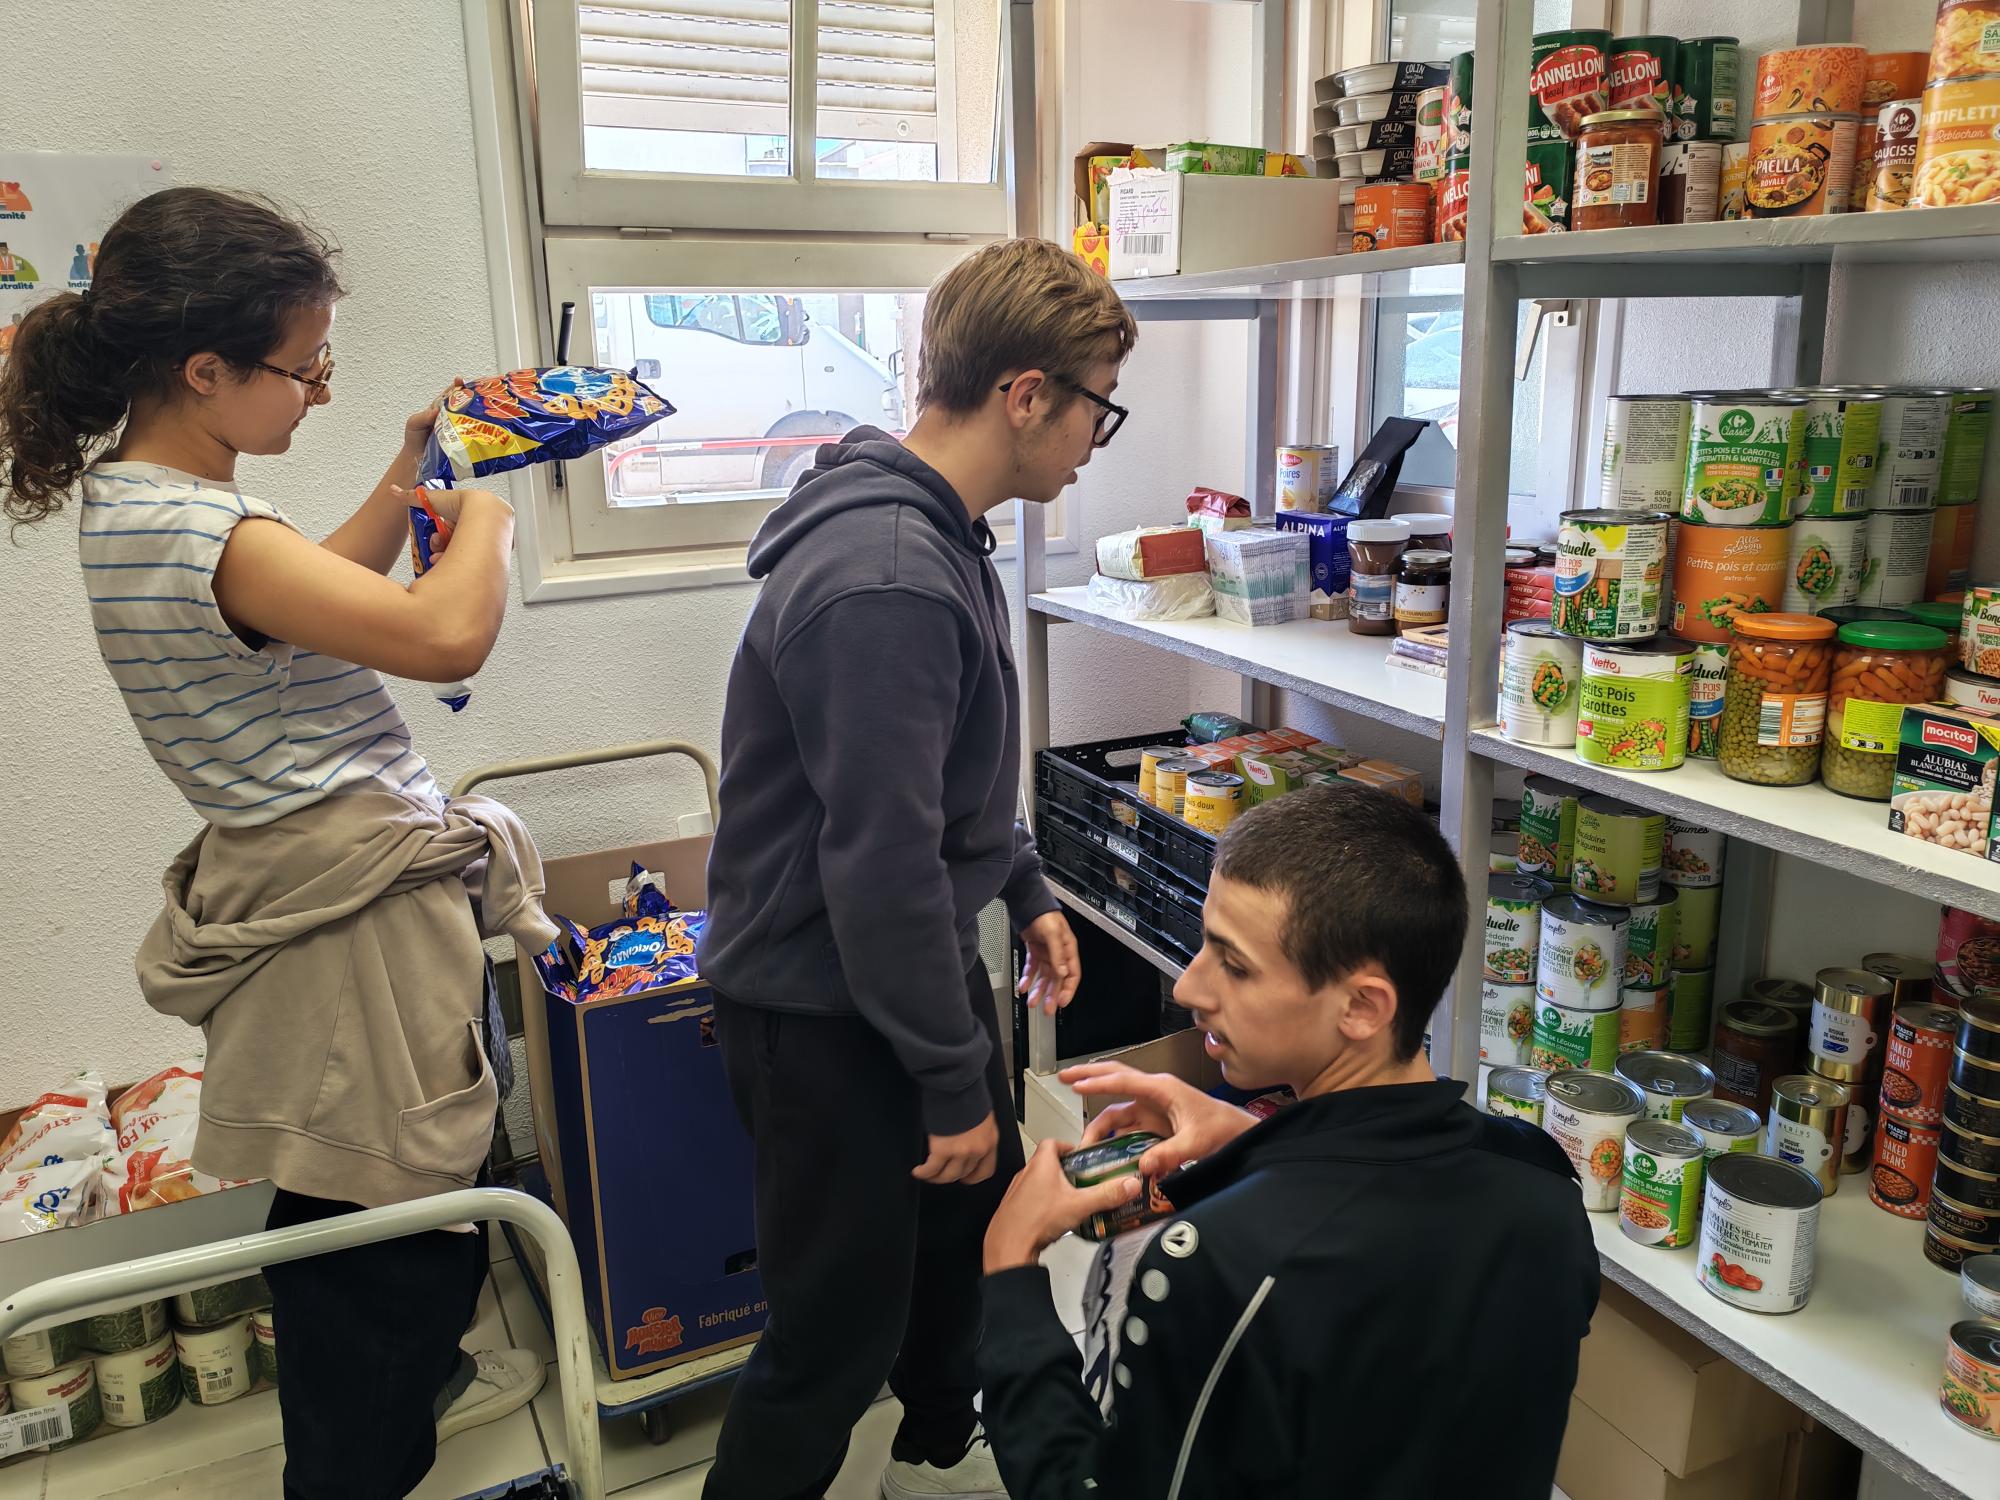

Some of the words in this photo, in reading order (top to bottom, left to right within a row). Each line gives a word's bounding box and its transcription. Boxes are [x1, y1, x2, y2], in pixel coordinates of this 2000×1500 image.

[1984, 29, 2000, 39] SA
[1529, 55, 1604, 92] CANNELLONI
[1380, 121, 1405, 134] COLIN
[1756, 157, 1800, 175] PAËLLA
[1742, 448, 1780, 460] CAROTTES
[1282, 521, 1326, 538] ALPINA
[1686, 556, 1714, 570] Petits
[1716, 560, 1740, 573] pois
[1742, 562, 1754, 572] et
[1591, 657, 1617, 670] Netto
[1582, 678, 1603, 698] Petits
[1608, 686, 1636, 702] Pois
[1703, 683, 1720, 692] POIS
[1582, 695, 1626, 716] Carottes
[1926, 726, 1974, 744] mocitos
[1910, 759, 1944, 774] BLANCAS
[1944, 768, 1979, 782] COCIDAS
[1924, 754, 1968, 772] ALUBIAS
[612, 940, 661, 964] ORIGINAL
[1556, 1036, 1585, 1052] LÉGUMES
[1890, 1040, 1912, 1058] BAKED
[1888, 1052, 1912, 1071] BEANS
[1888, 1124, 1908, 1136] TRADER
[1884, 1138, 1908, 1157] BAKED
[1882, 1150, 1906, 1170] BEANS
[1646, 1182, 1672, 1196] BLANCS
[1708, 1208, 1740, 1234] TOMATES
[1742, 1228, 1760, 1240] HELE
[1742, 1236, 1773, 1250] TOMATEN
[698, 1304, 750, 1328] Fabriqué
[754, 1300, 768, 1312] en
[10, 1414, 28, 1422] verts
